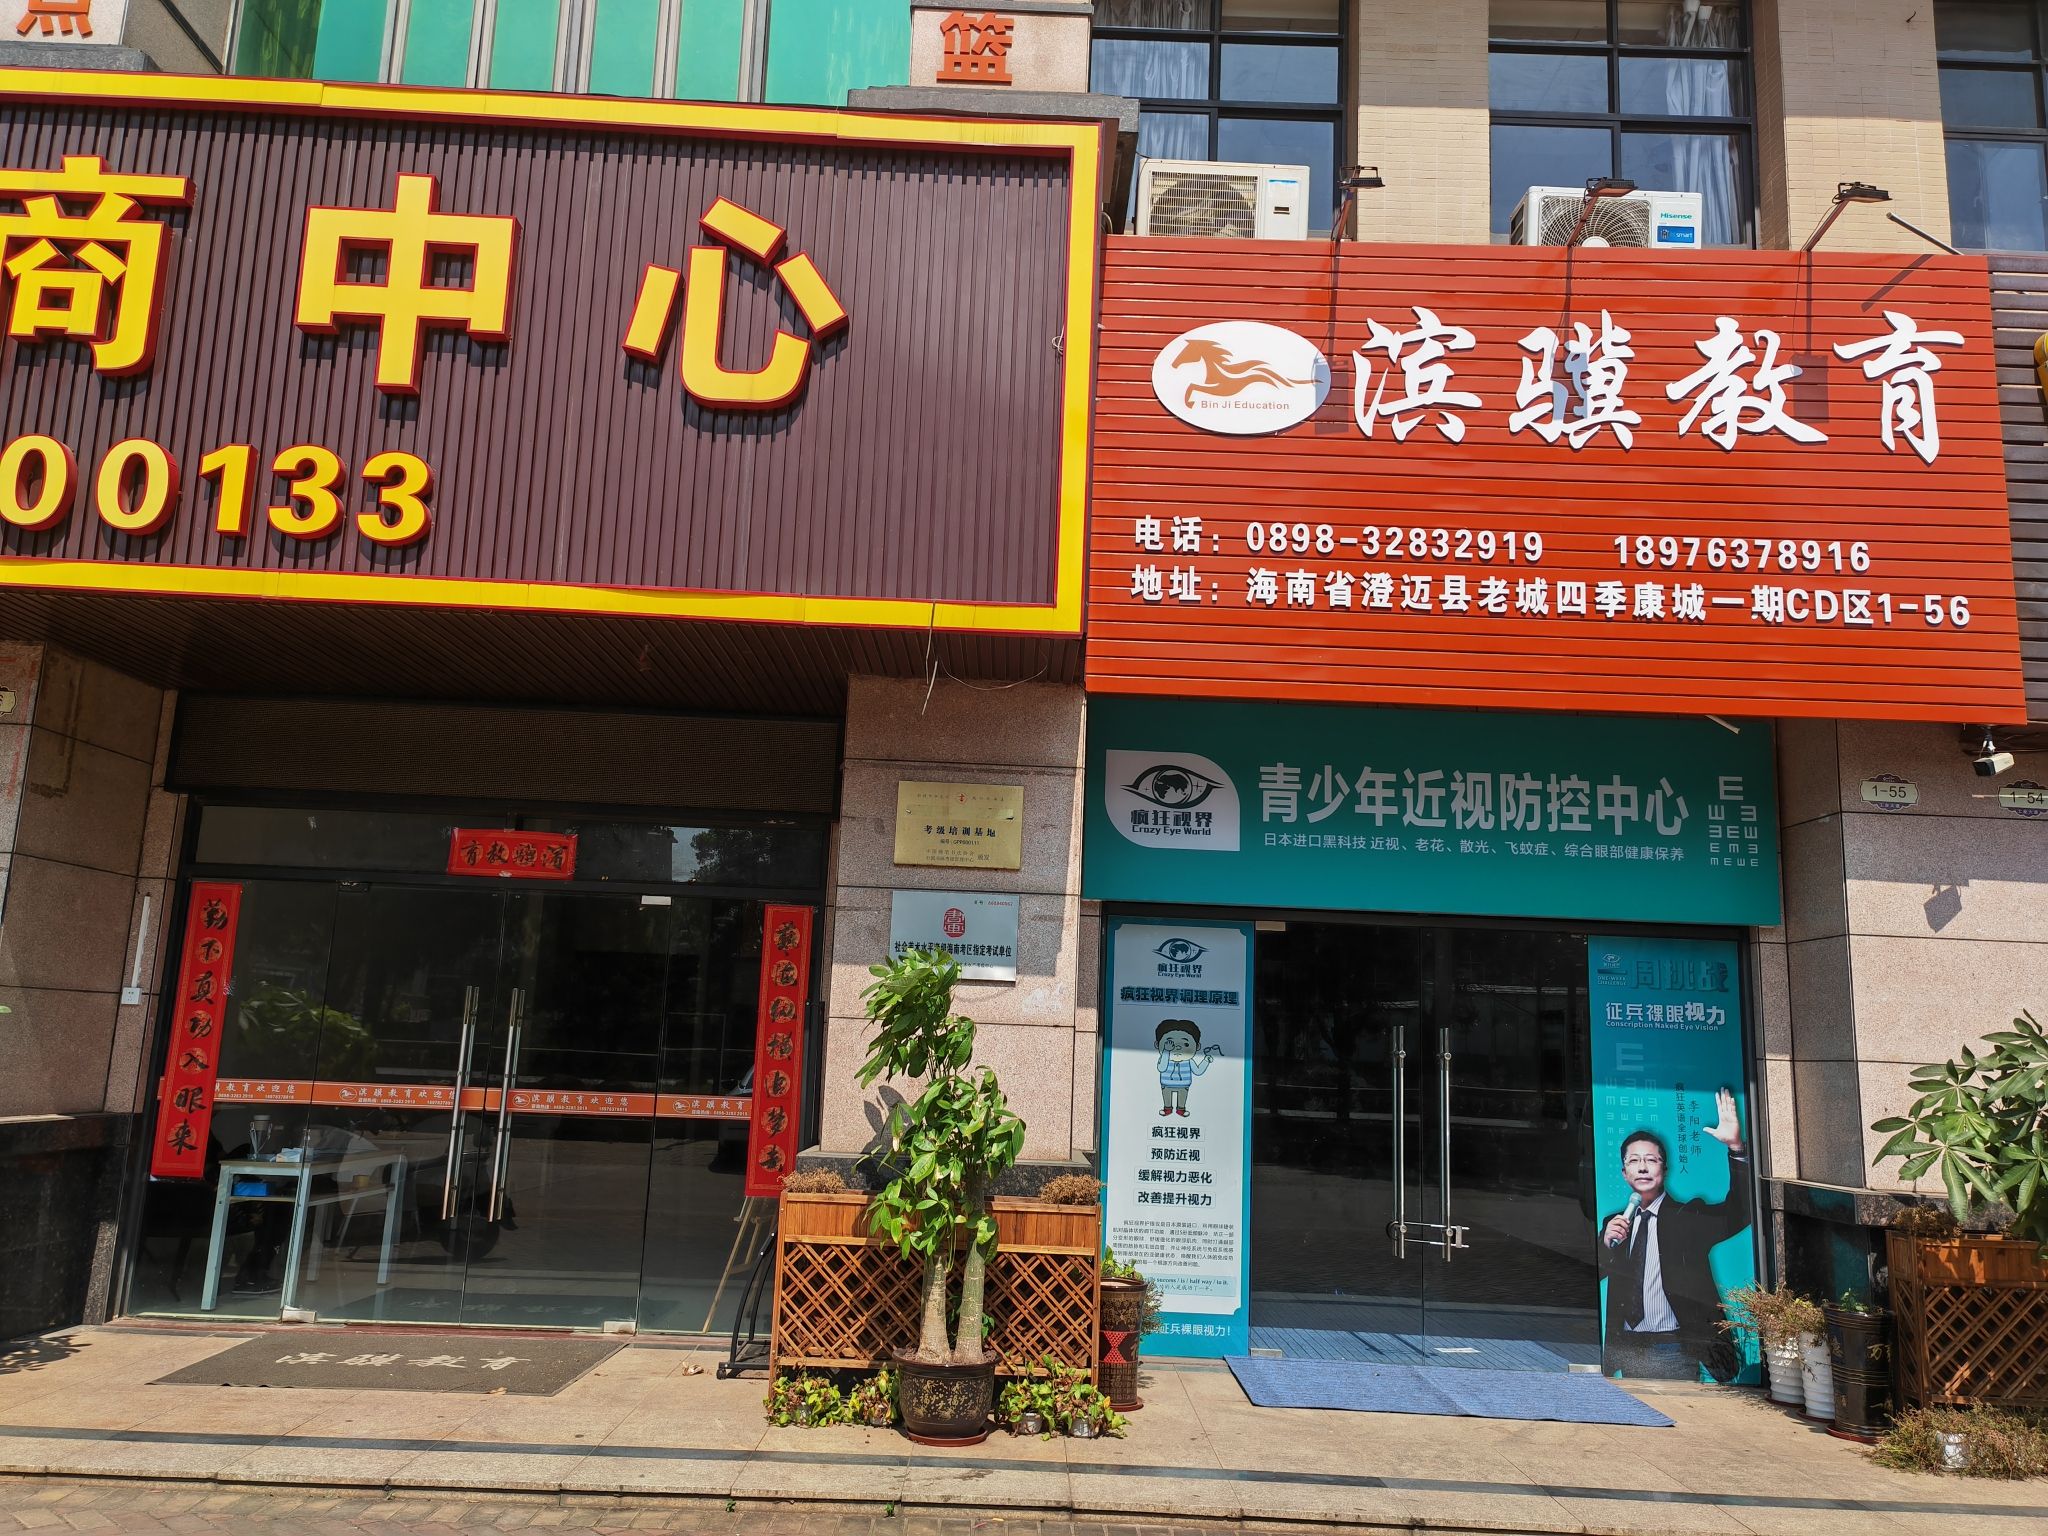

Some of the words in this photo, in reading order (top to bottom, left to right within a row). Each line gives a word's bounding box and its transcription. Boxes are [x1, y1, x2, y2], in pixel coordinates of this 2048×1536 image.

[937, 12, 1015, 84] 篮
[1660, 212, 1692, 220] Hisense
[1352, 306, 1965, 465] 滨骥教育
[1201, 400, 1219, 410] Bin
[1222, 400, 1232, 410] Ji
[1235, 401, 1290, 411] Education
[1246, 520, 1544, 562] 0898-32832919
[1613, 534, 1871, 573] 18976378916
[1258, 762, 1690, 836] 青少年近视防控中心
[1871, 785, 1907, 798] 1-55
[2010, 791, 2045, 805] 1-54
[1130, 809, 1213, 828] 疯狂视界
[1132, 825, 1161, 836] Crazy
[1163, 826, 1182, 837] Eye
[1184, 826, 1211, 836] World
[1263, 832, 1367, 850] 日本进口黑科技
[1605, 1001, 1726, 1026] 征兵裸眼视力
[1605, 1020, 1653, 1030] Conscription
[1655, 1022, 1679, 1030] Naked
[1681, 1023, 1694, 1031] Eye
[1695, 1024, 1719, 1032] Vision
[1151, 1126, 1201, 1139] 疯狂视界
[1689, 1100, 1702, 1158] 李阳老师
[1150, 1148, 1200, 1161] 预防近视
[1137, 1169, 1213, 1184] 缓解视力恶化
[1137, 1191, 1212, 1206] 改善提升视力
